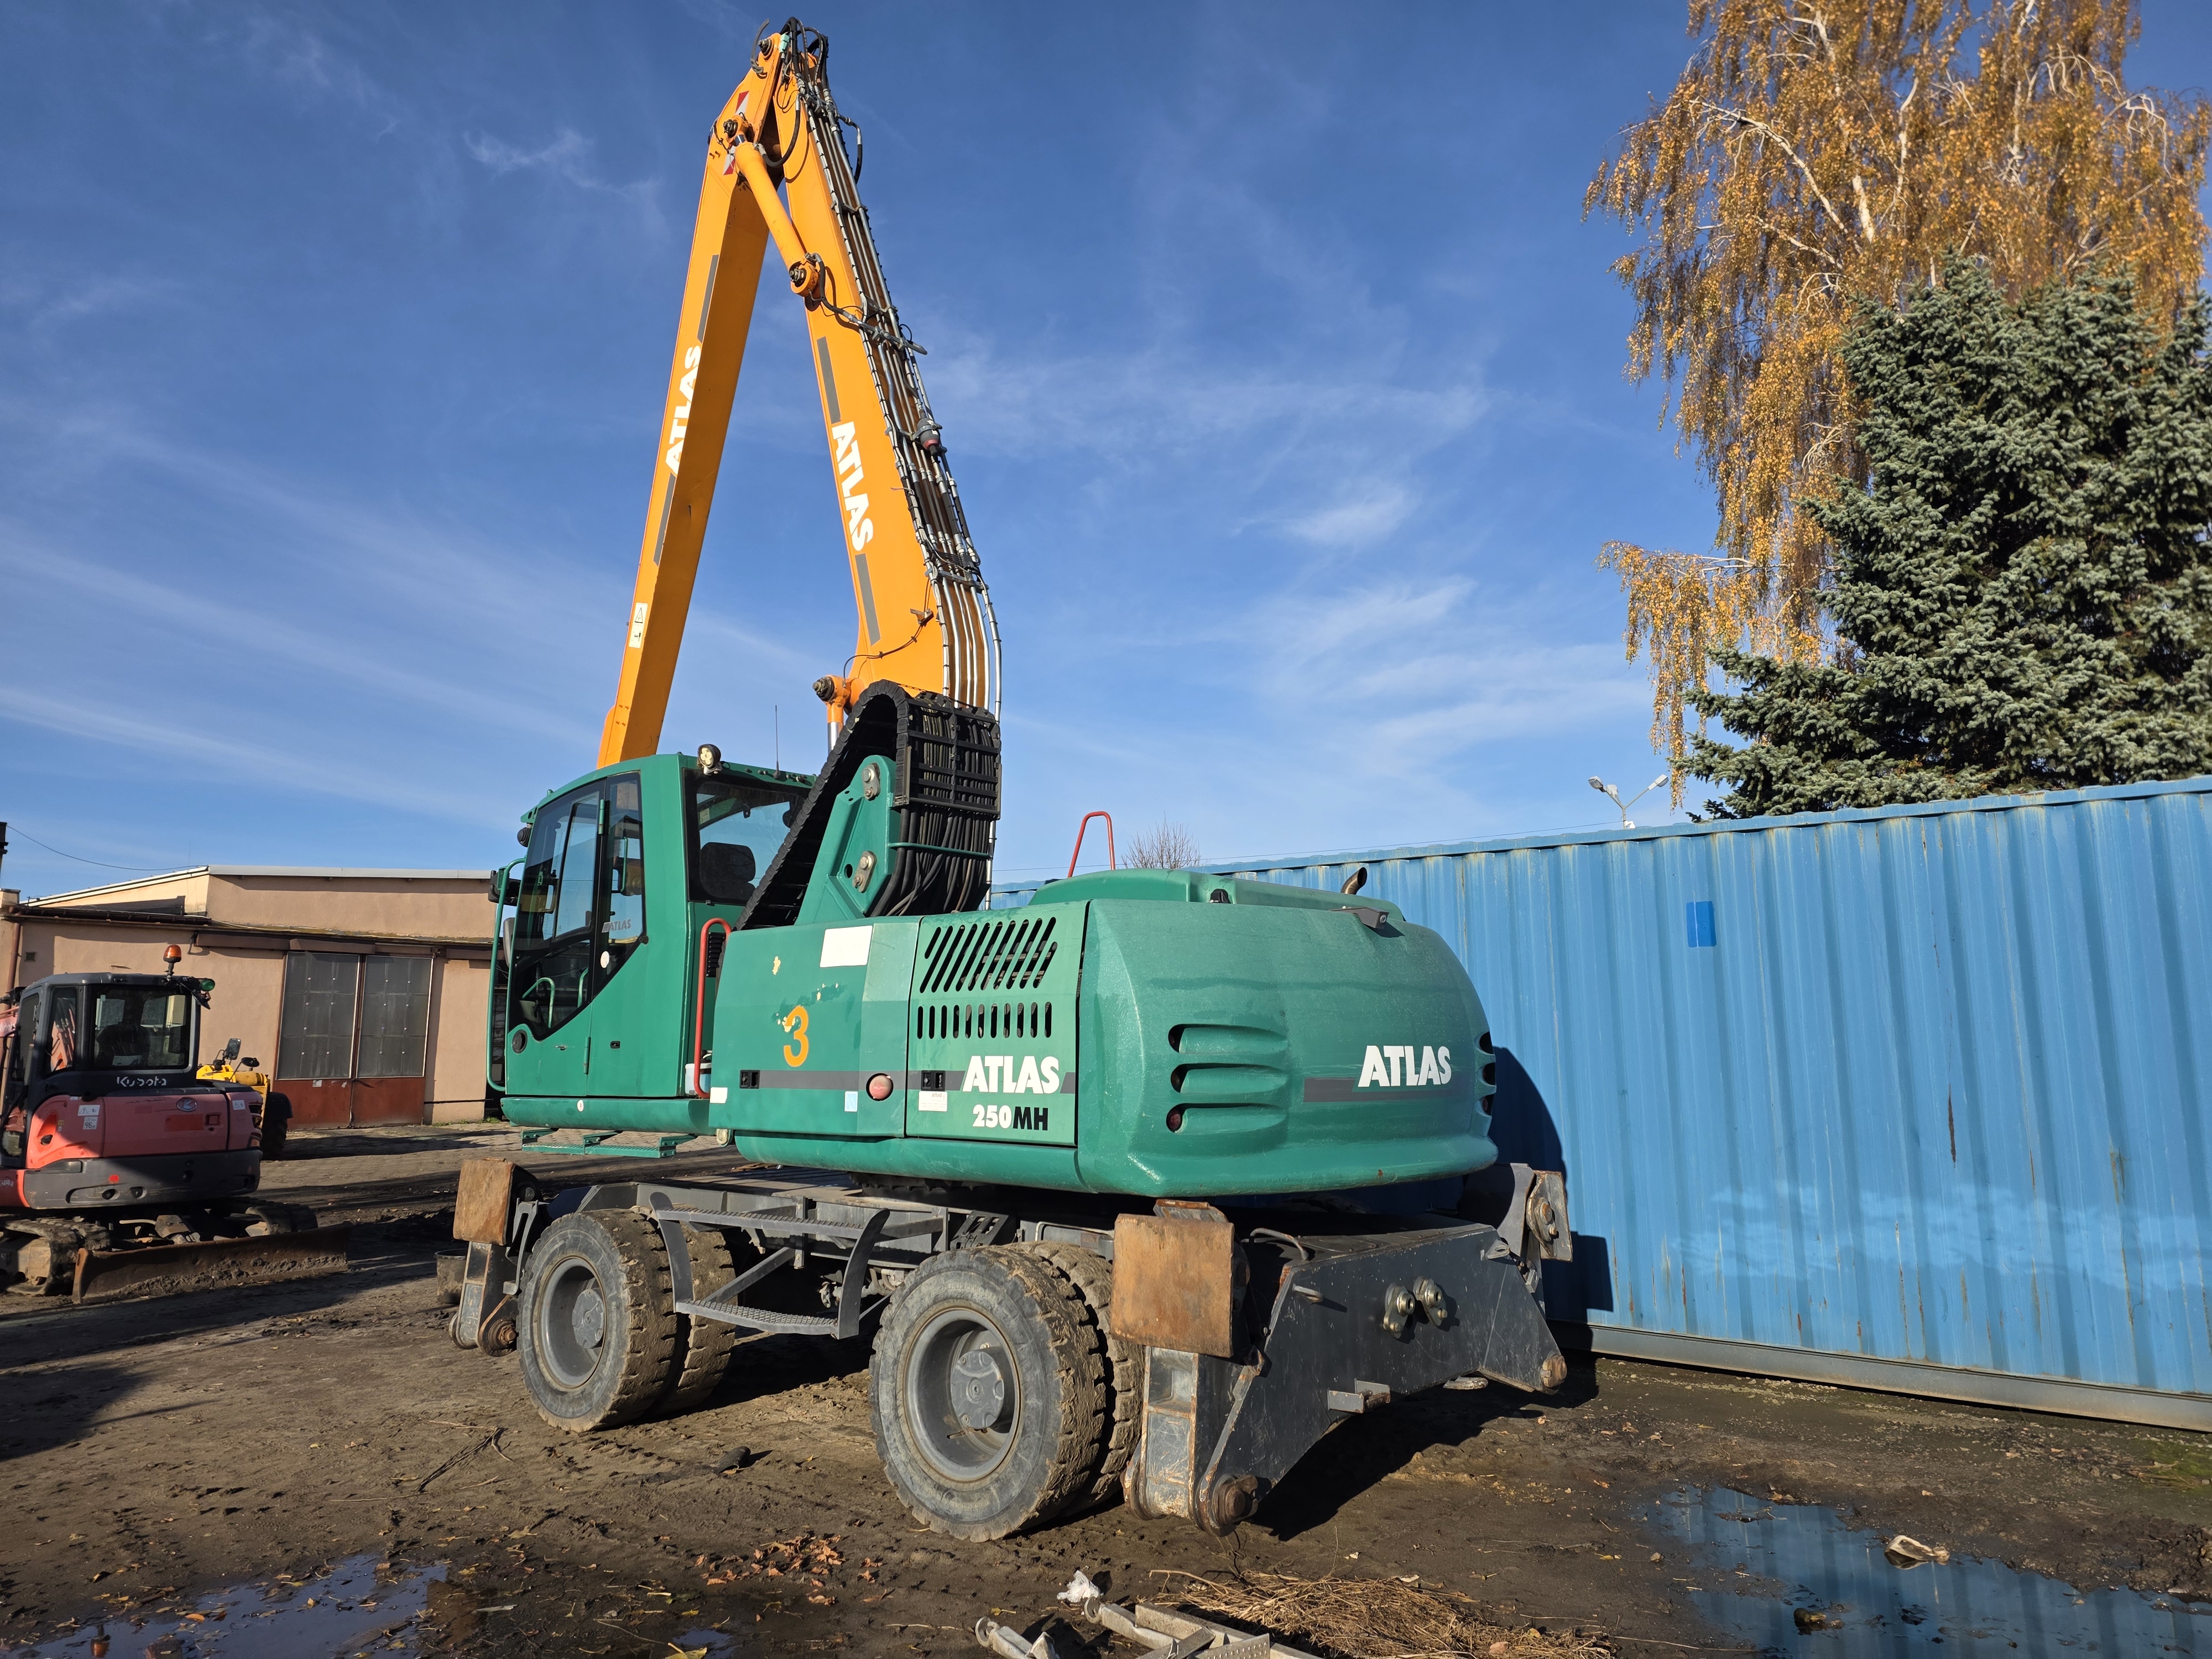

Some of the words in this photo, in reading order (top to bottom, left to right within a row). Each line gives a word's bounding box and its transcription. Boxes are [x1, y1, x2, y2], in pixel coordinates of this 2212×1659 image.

[665, 345, 701, 477] ATLAS
[831, 421, 874, 551] ATLAS
[608, 919, 632, 932] ATLAS
[783, 1005, 809, 1068] 3
[117, 1076, 167, 1087] Kubota
[962, 1055, 1060, 1094] ATLAS
[1358, 1045, 1452, 1087] ATLAS
[972, 1104, 1049, 1131] 250MH
